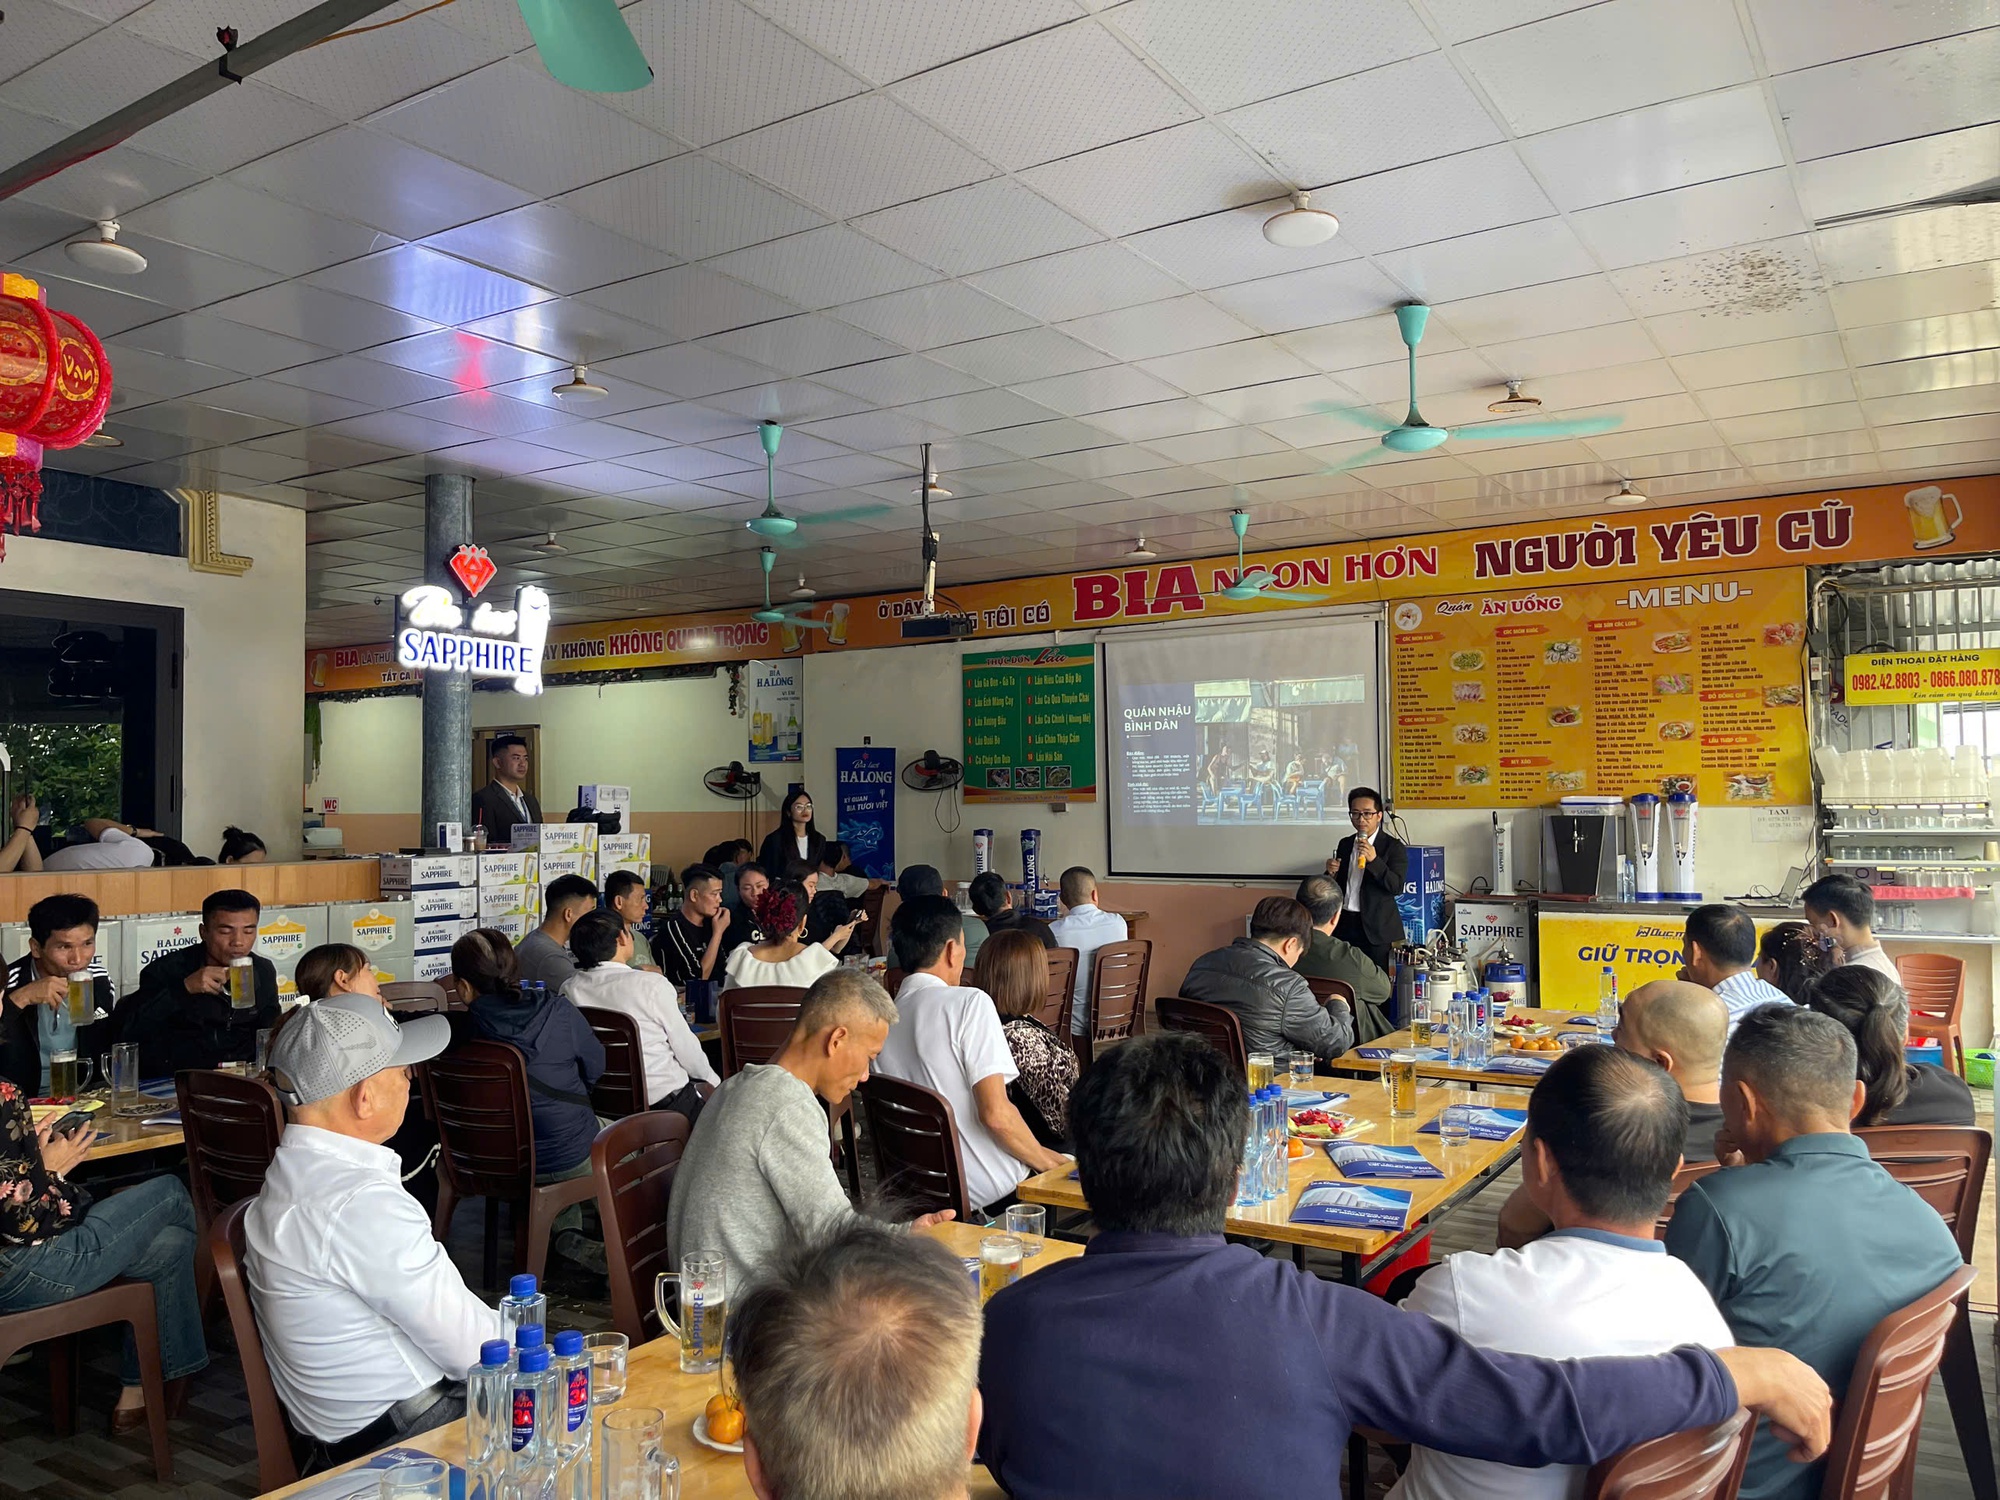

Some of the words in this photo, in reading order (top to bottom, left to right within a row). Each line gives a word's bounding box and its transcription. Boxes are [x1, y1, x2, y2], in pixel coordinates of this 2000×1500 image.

[1474, 523, 1638, 579] NGƯỜI
[1650, 512, 1761, 562] YÊU
[1776, 500, 1854, 553] CŨ
[1345, 545, 1438, 583] HƠN
[1073, 566, 1204, 622] BIA
[878, 602, 889, 618] Ở
[893, 599, 924, 617] ĐÂY
[1435, 601, 1473, 616] Quán
[1481, 598, 1510, 616] ĂN
[1511, 592, 1562, 614] UỐNG
[984, 606, 1016, 629] TÔI
[1022, 600, 1051, 624] CÓ
[561, 637, 605, 658] KHÔNG
[609, 628, 663, 656] KHÔNG
[712, 622, 769, 652] TRỌNG
[335, 650, 359, 667] BIA
[404, 632, 533, 673] SAPPHIRE
[1871, 657, 1893, 668] ĐIỆN
[1896, 656, 1925, 666] THOẠI
[1928, 654, 1948, 665] ĐẶT
[1950, 652, 1980, 662] HÀNG
[769, 669, 781, 677] BIA
[1852, 671, 1920, 691] 0982.42.8803
[1124, 705, 1156, 719] QUÁN
[1158, 704, 1191, 718] NHẬU
[1124, 719, 1152, 732] BÌNH
[1154, 718, 1178, 730] DÂN
[324, 799, 337, 809] WC
[513, 824, 537, 833] SAPPHIRE
[544, 832, 578, 840] SAPPHIRE
[603, 842, 633, 851] SAPPHIRE
[484, 863, 518, 873] SAPPHIRE
[543, 861, 576, 870] SAPPHIRE
[382, 876, 409, 886] SAPPHIRE
[420, 869, 452, 879] SAPPHIRE
[484, 894, 519, 903] SAPPHIRE
[420, 902, 453, 912] SAPPHIRE
[356, 926, 392, 936] SAPPHIRE
[420, 933, 452, 943] SAPPHIRE
[1461, 924, 1524, 938] SAPPHIRE
[262, 934, 301, 944] SAPPHIRE
[1578, 943, 1620, 962] GIỮ
[693, 1292, 703, 1357] SAPPHIRE
[514, 1409, 533, 1425] 3A
